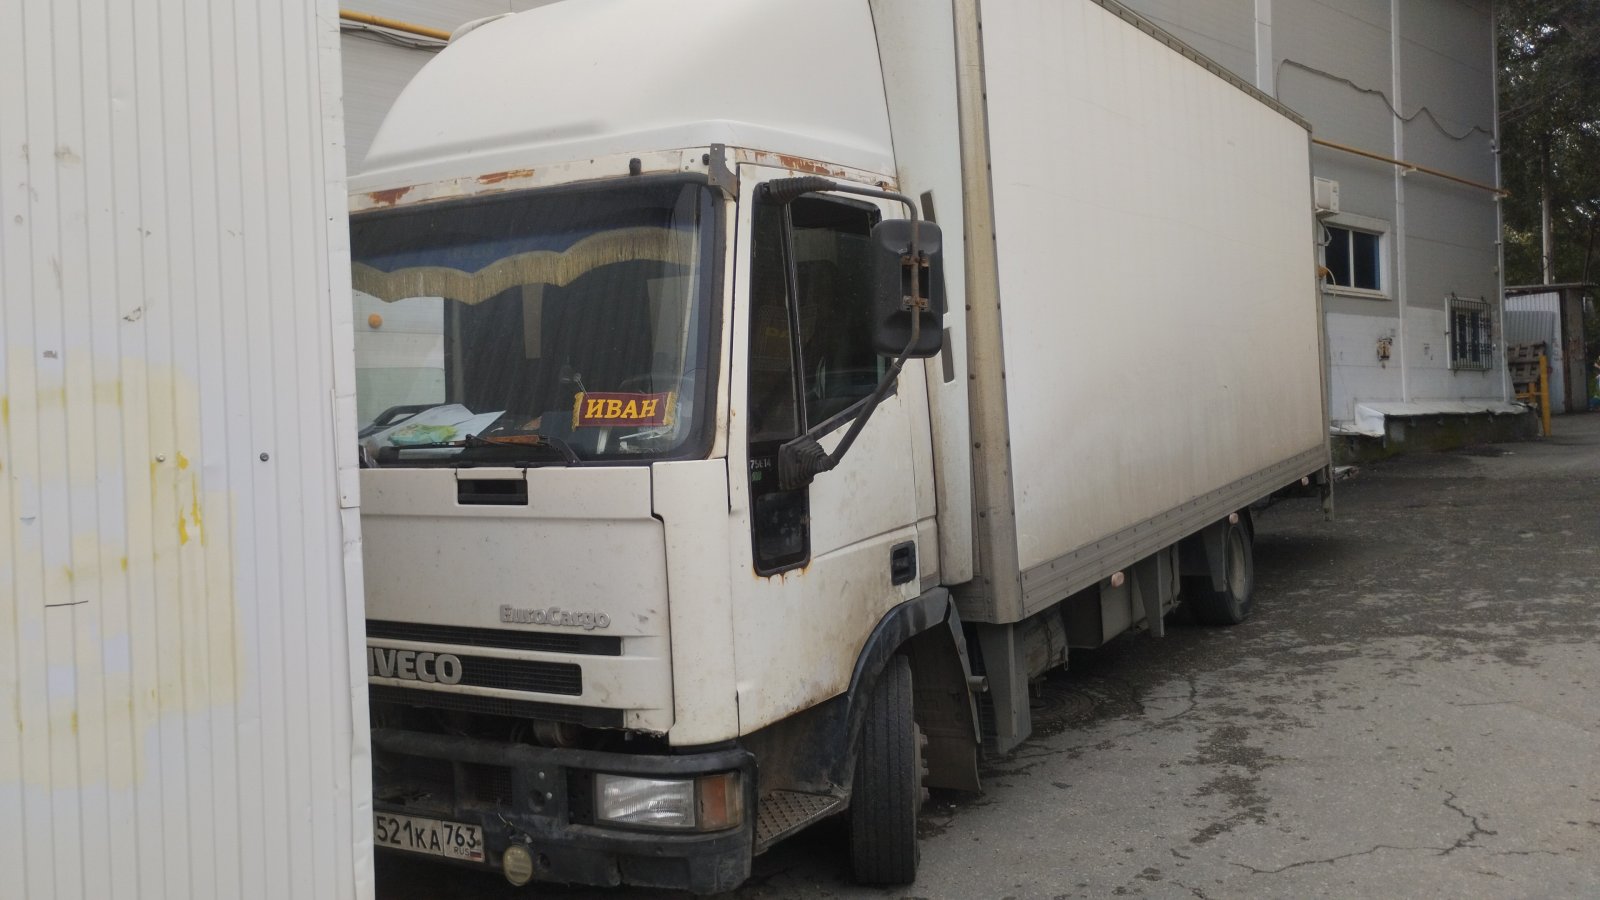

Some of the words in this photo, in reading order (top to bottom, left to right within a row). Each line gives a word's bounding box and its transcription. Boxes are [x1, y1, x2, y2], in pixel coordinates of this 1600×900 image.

[585, 399, 659, 419] ИВАН
[499, 604, 612, 631] EuroCargo
[367, 647, 463, 685] IVECO
[444, 824, 477, 848] 763
[453, 846, 470, 856] RUS
